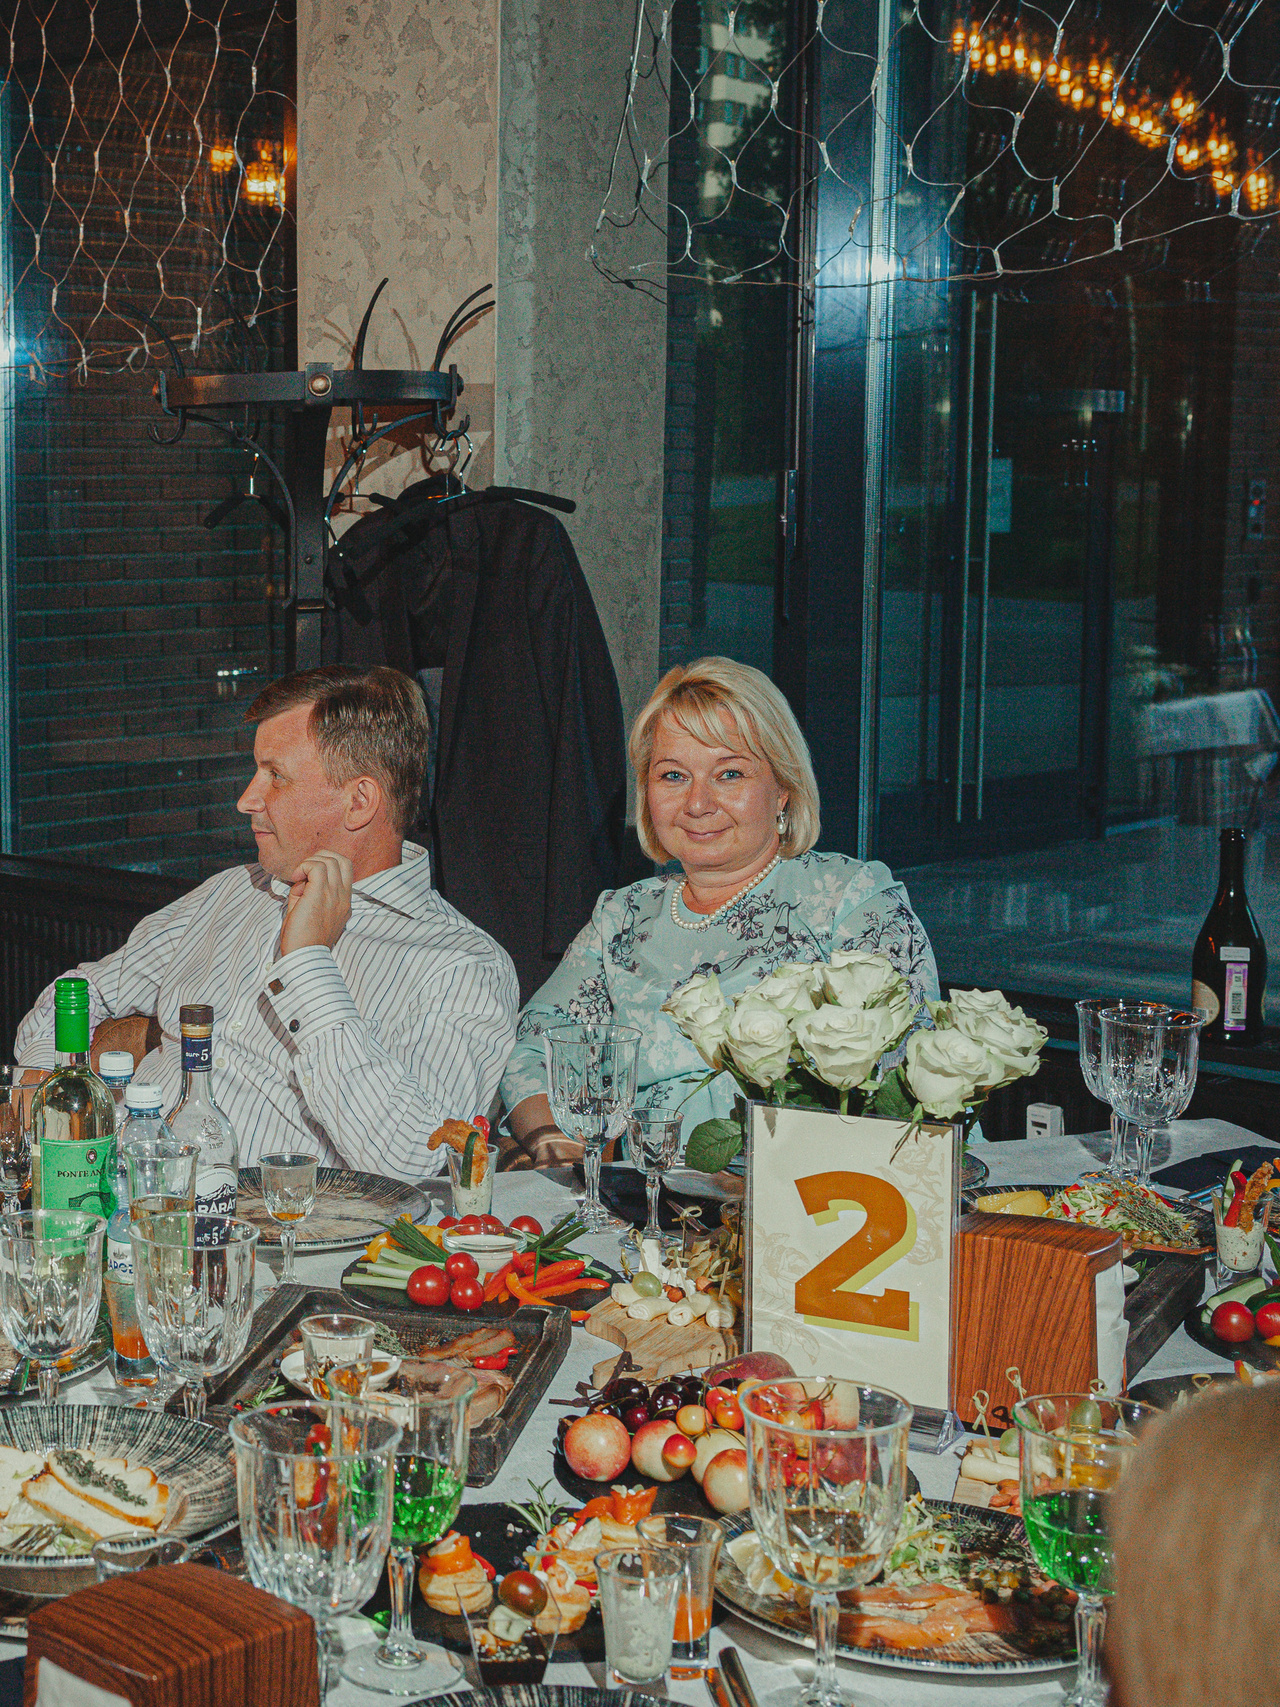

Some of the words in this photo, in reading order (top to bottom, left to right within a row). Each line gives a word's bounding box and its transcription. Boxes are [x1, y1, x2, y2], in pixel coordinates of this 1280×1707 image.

[200, 1048, 209, 1062] 5
[57, 1170, 89, 1178] PONTE
[195, 1197, 236, 1214] RARAT
[211, 1226, 219, 1245] 5
[794, 1170, 919, 1342] 2
